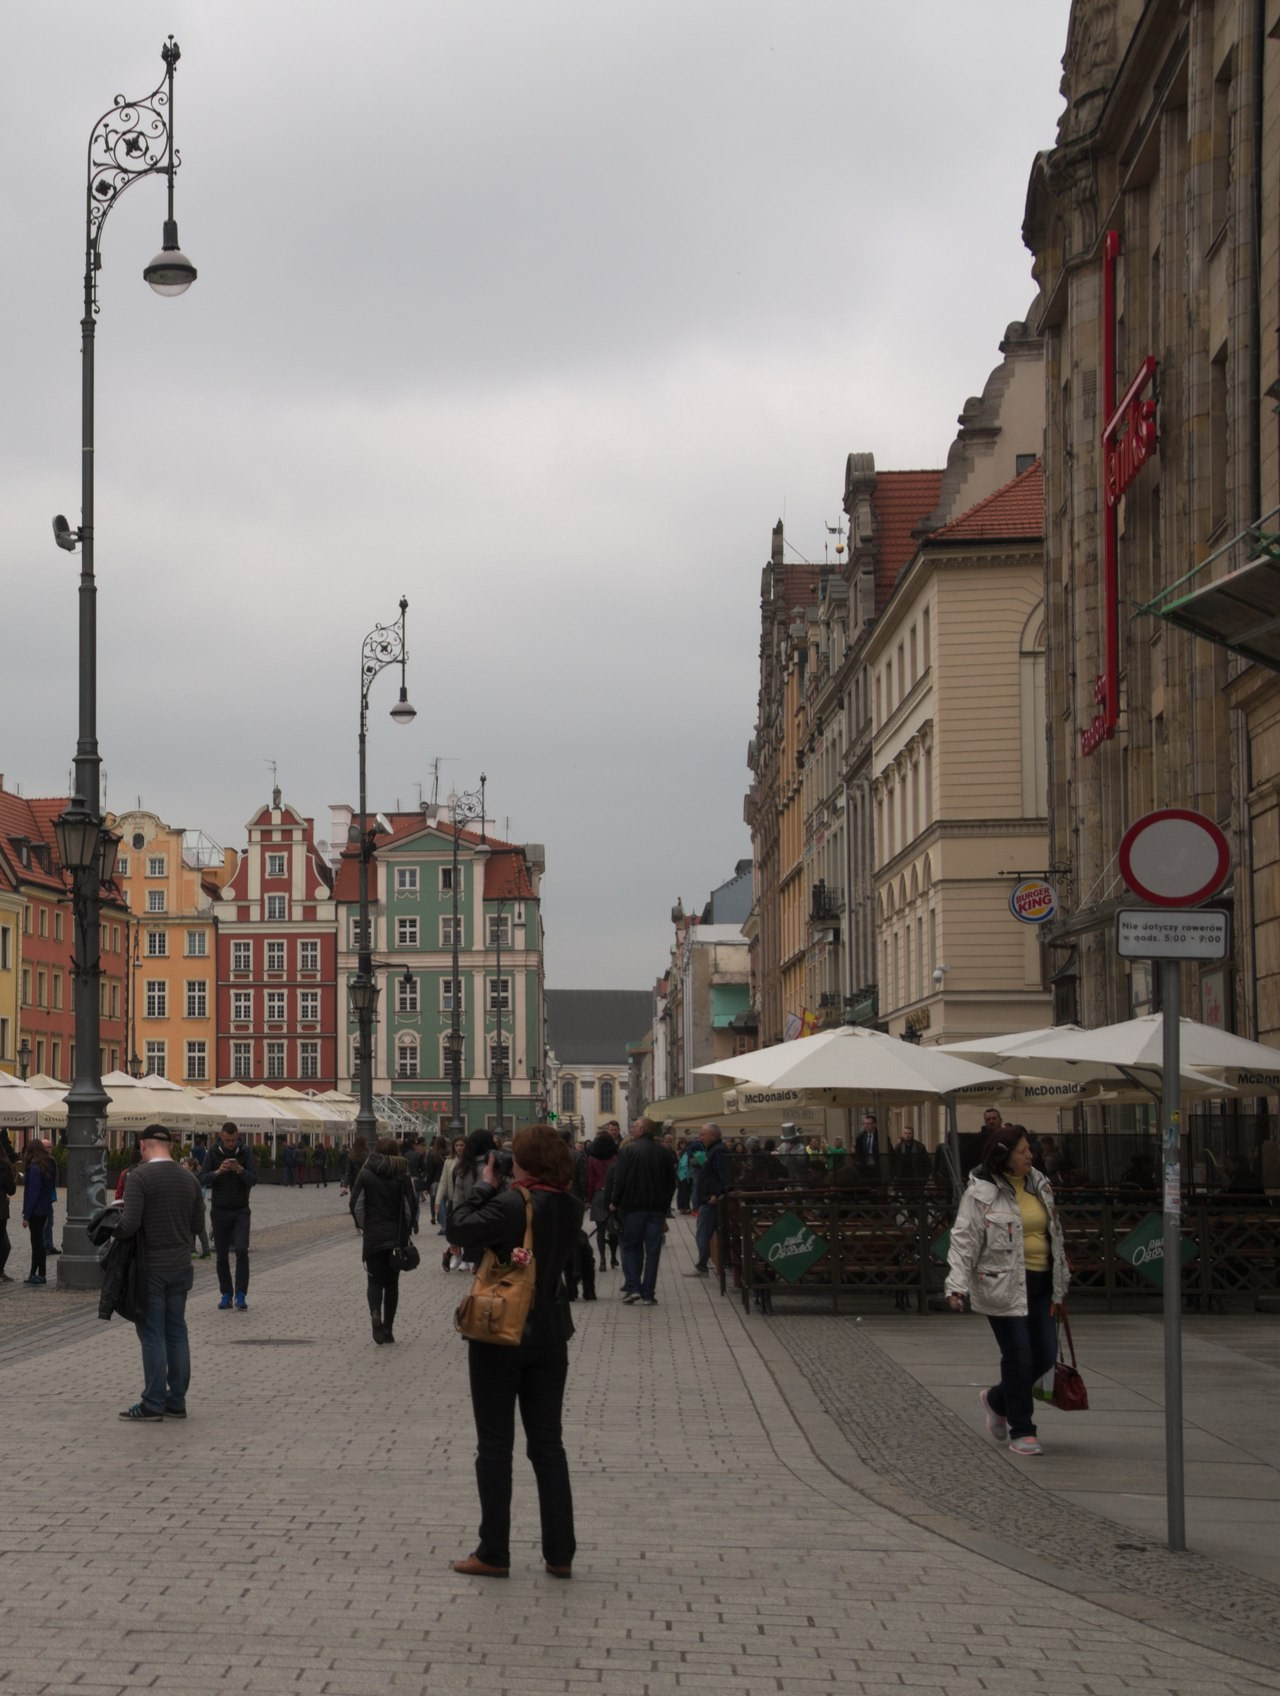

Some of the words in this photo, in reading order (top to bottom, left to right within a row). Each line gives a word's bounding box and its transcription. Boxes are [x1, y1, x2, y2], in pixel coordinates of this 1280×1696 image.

[1016, 887, 1051, 904] BURGER
[1018, 895, 1052, 914] KING
[1122, 922, 1138, 931] Nie
[1142, 922, 1178, 933] dotyczy
[1182, 923, 1223, 932] rowerów
[1134, 934, 1160, 943] godz.
[1164, 934, 1186, 943] 5:00
[1199, 935, 1221, 944] 9:00
[744, 1088, 798, 1104] McDonald's
[1024, 1082, 1087, 1097] McDonald's
[404, 1101, 449, 1112] APTEK
